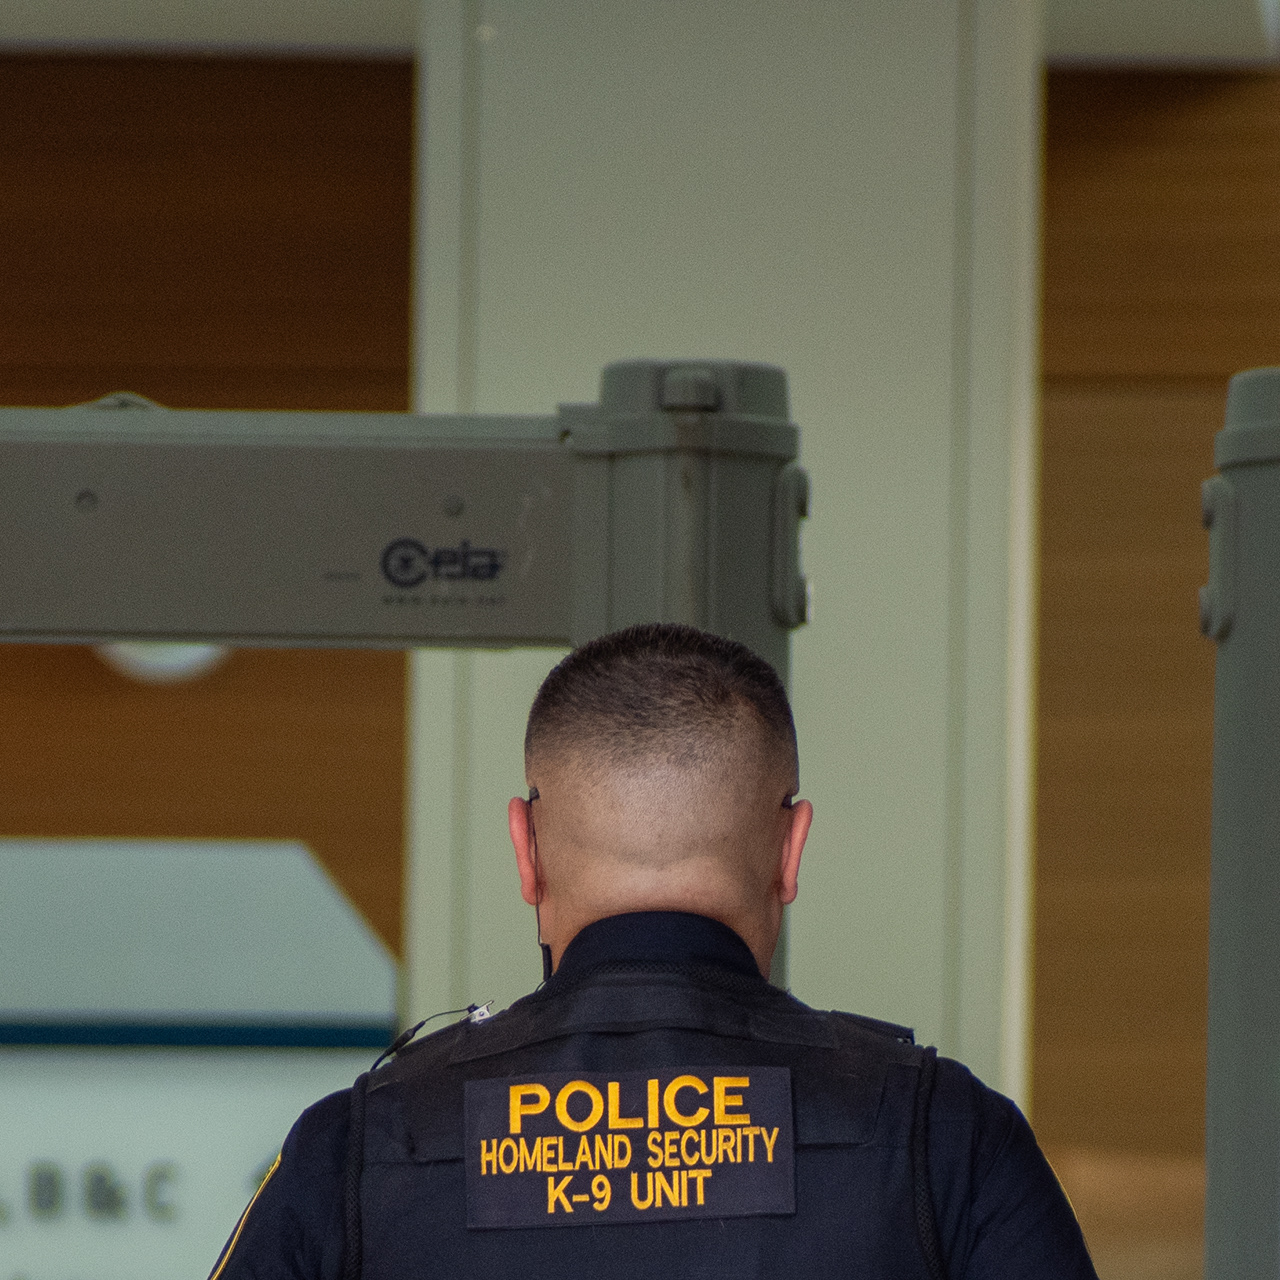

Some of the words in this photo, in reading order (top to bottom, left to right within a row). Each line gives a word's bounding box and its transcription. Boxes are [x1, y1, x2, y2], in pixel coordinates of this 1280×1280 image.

[509, 1075, 750, 1133] POLICE
[481, 1134, 632, 1175] HOMELAND
[647, 1127, 779, 1168] SECURITY
[547, 1174, 612, 1213] K-9
[631, 1169, 712, 1210] UNIT
